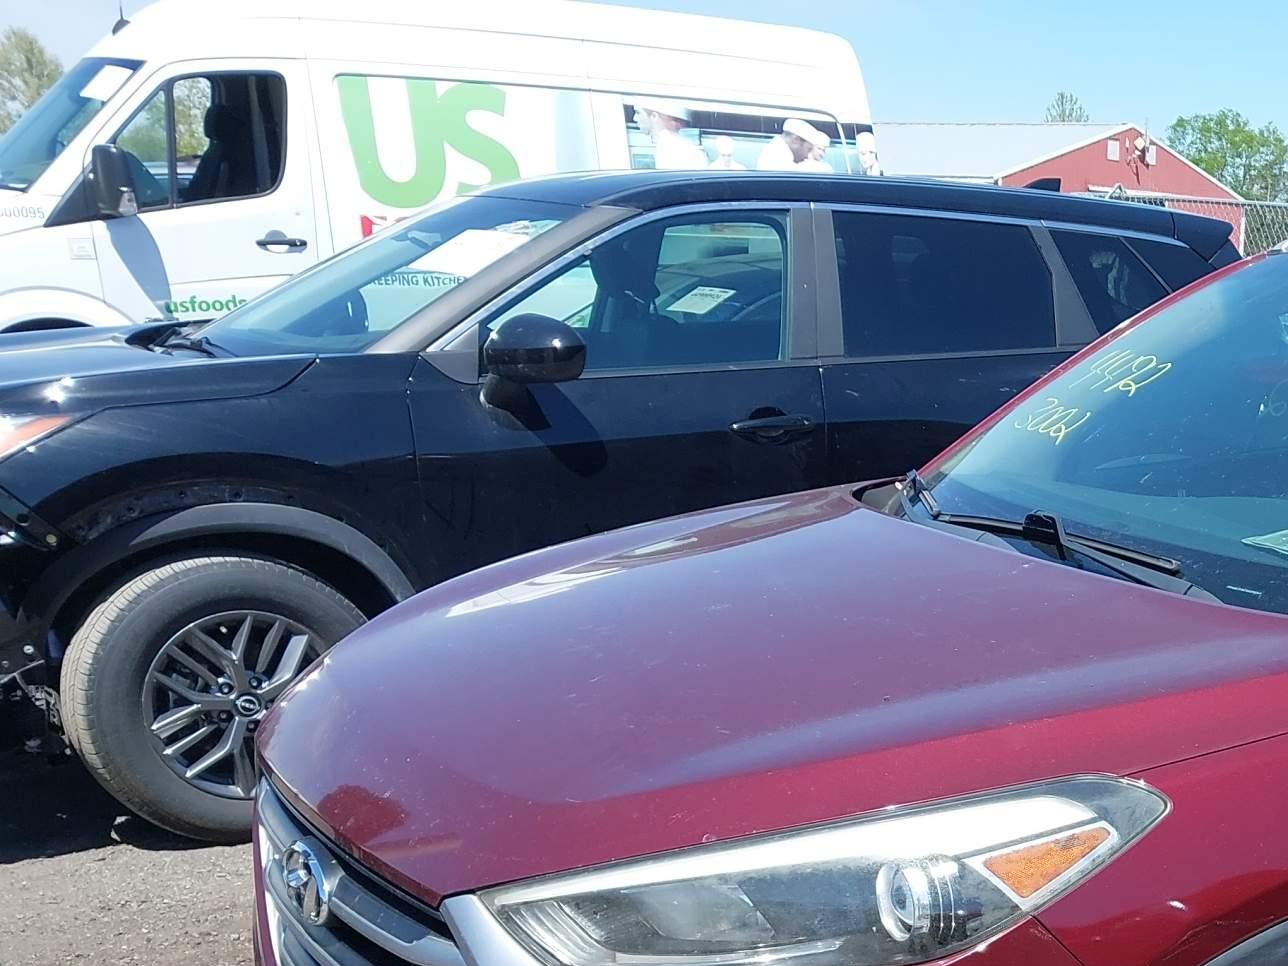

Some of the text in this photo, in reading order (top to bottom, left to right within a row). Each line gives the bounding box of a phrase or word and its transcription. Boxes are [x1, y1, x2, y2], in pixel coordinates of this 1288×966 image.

[337, 76, 521, 208] US
[0, 206, 45, 219] 00095
[373, 274, 419, 287] EEPING
[1068, 349, 1174, 397] 4492
